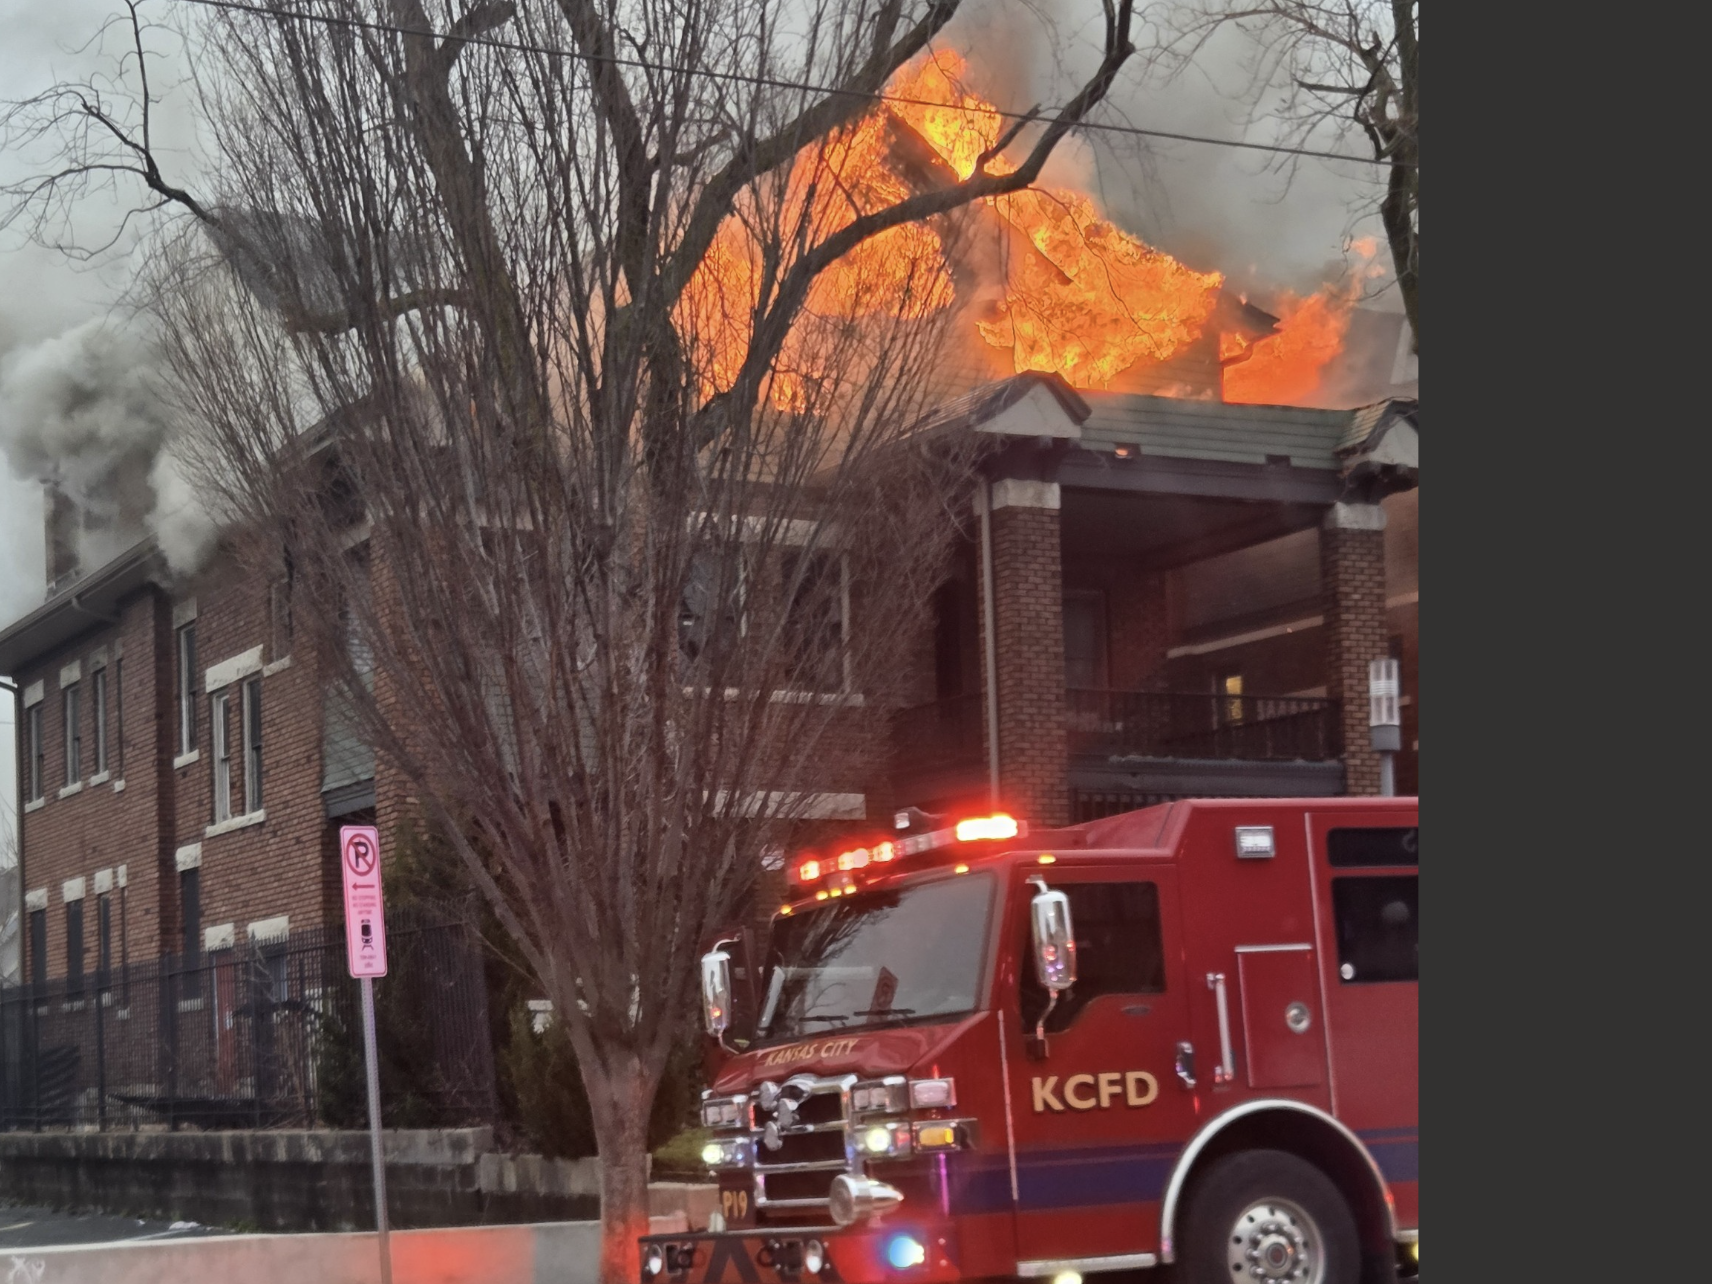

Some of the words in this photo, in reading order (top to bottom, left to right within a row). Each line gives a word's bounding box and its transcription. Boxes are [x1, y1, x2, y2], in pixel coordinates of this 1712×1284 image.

[764, 1043, 818, 1066] KANSAS
[820, 1038, 860, 1058] CITY
[1031, 1070, 1159, 1112] KCFD
[722, 1189, 748, 1219] P19
